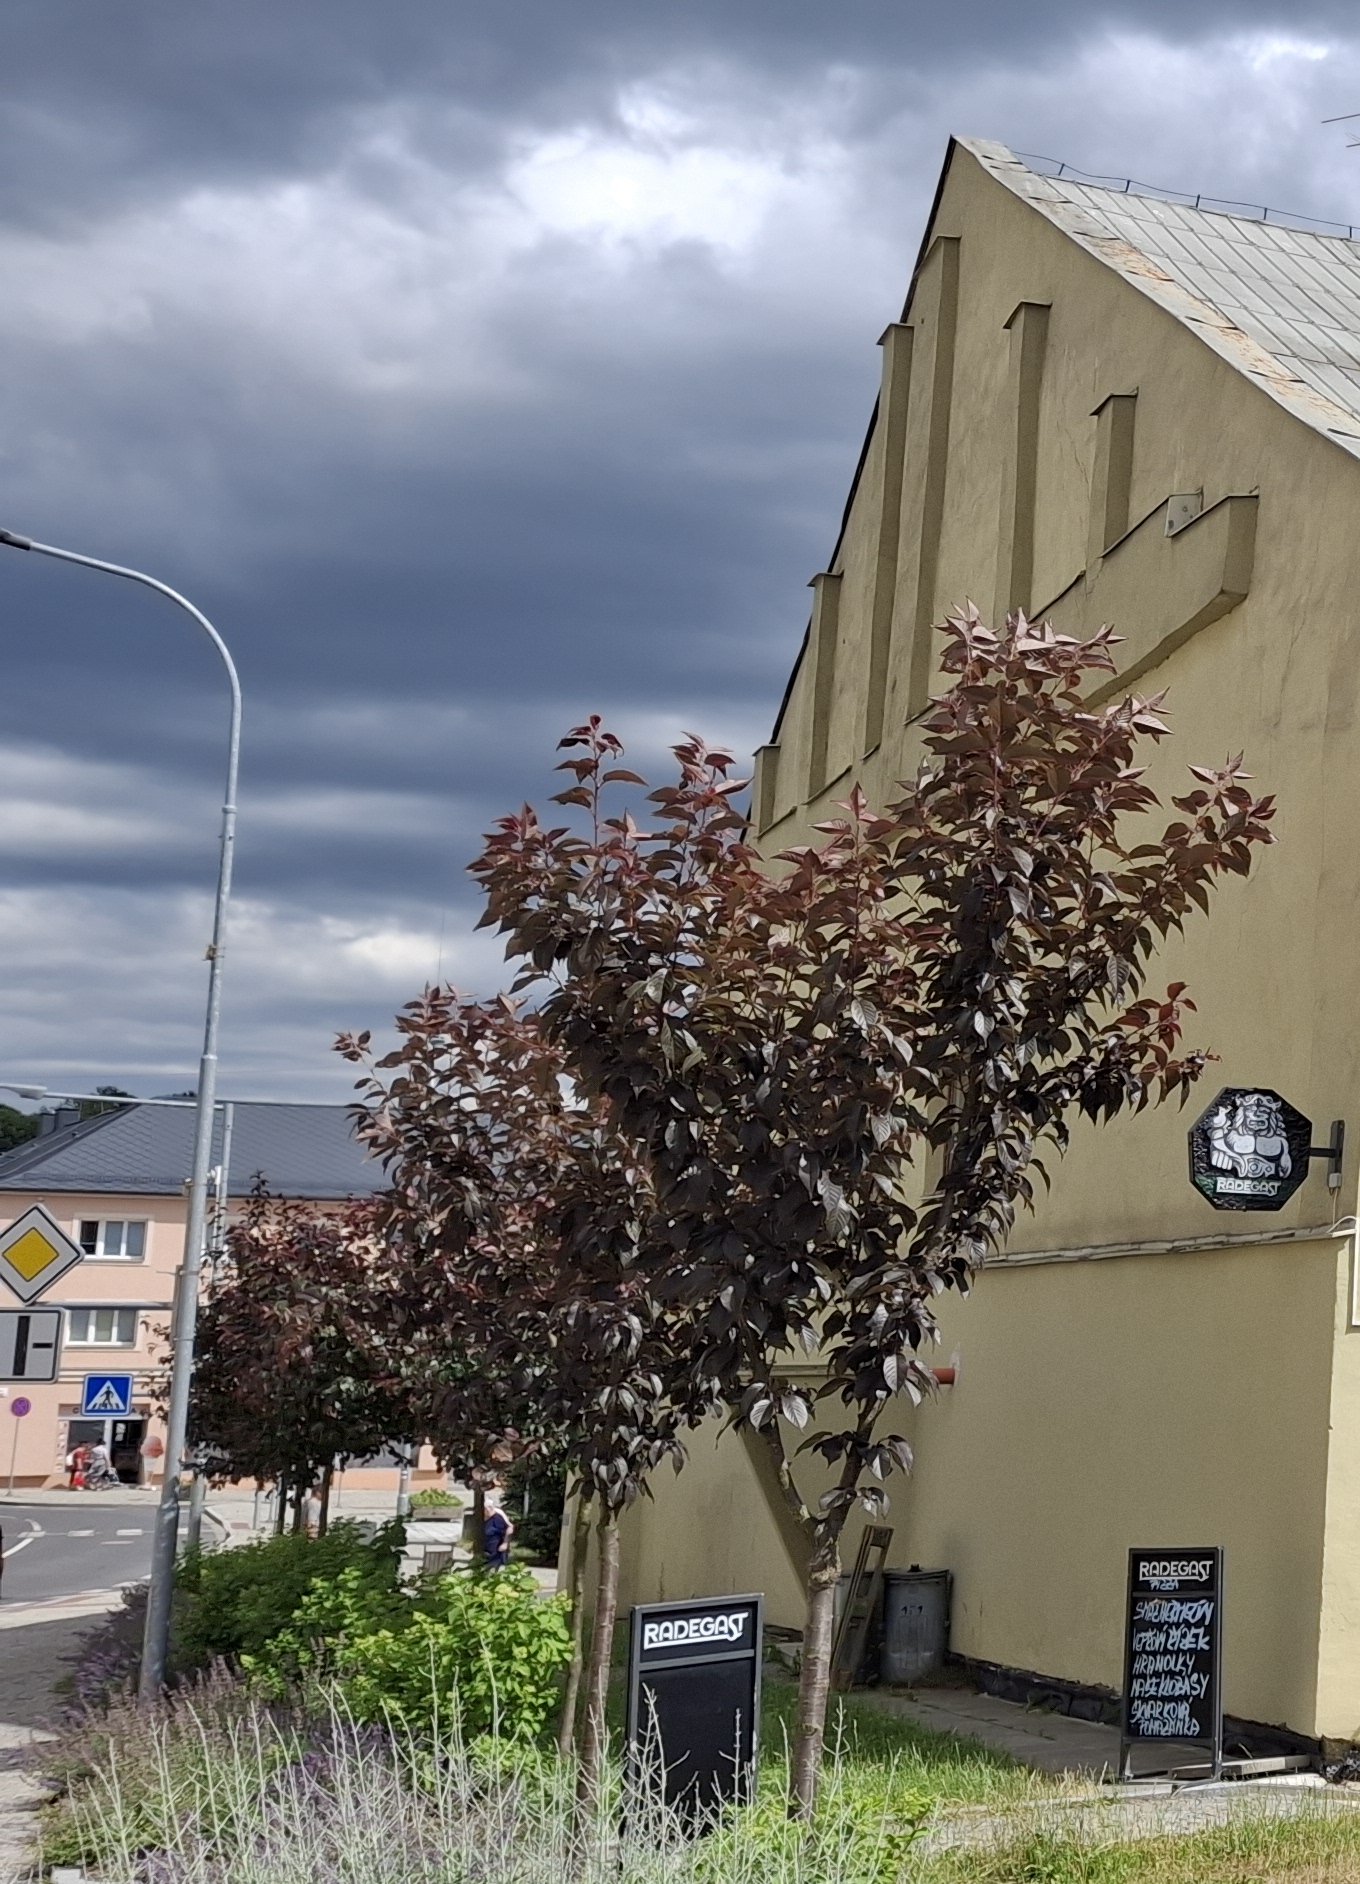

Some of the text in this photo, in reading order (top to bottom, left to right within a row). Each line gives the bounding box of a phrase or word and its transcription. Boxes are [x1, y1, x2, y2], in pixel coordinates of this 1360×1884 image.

[1216, 1177, 1282, 1197] RADEGAST
[1139, 1560, 1214, 1582] RADEGAST
[643, 1612, 749, 1651] RADEGAST
[1132, 1652, 1196, 1675] HRANOLKY
